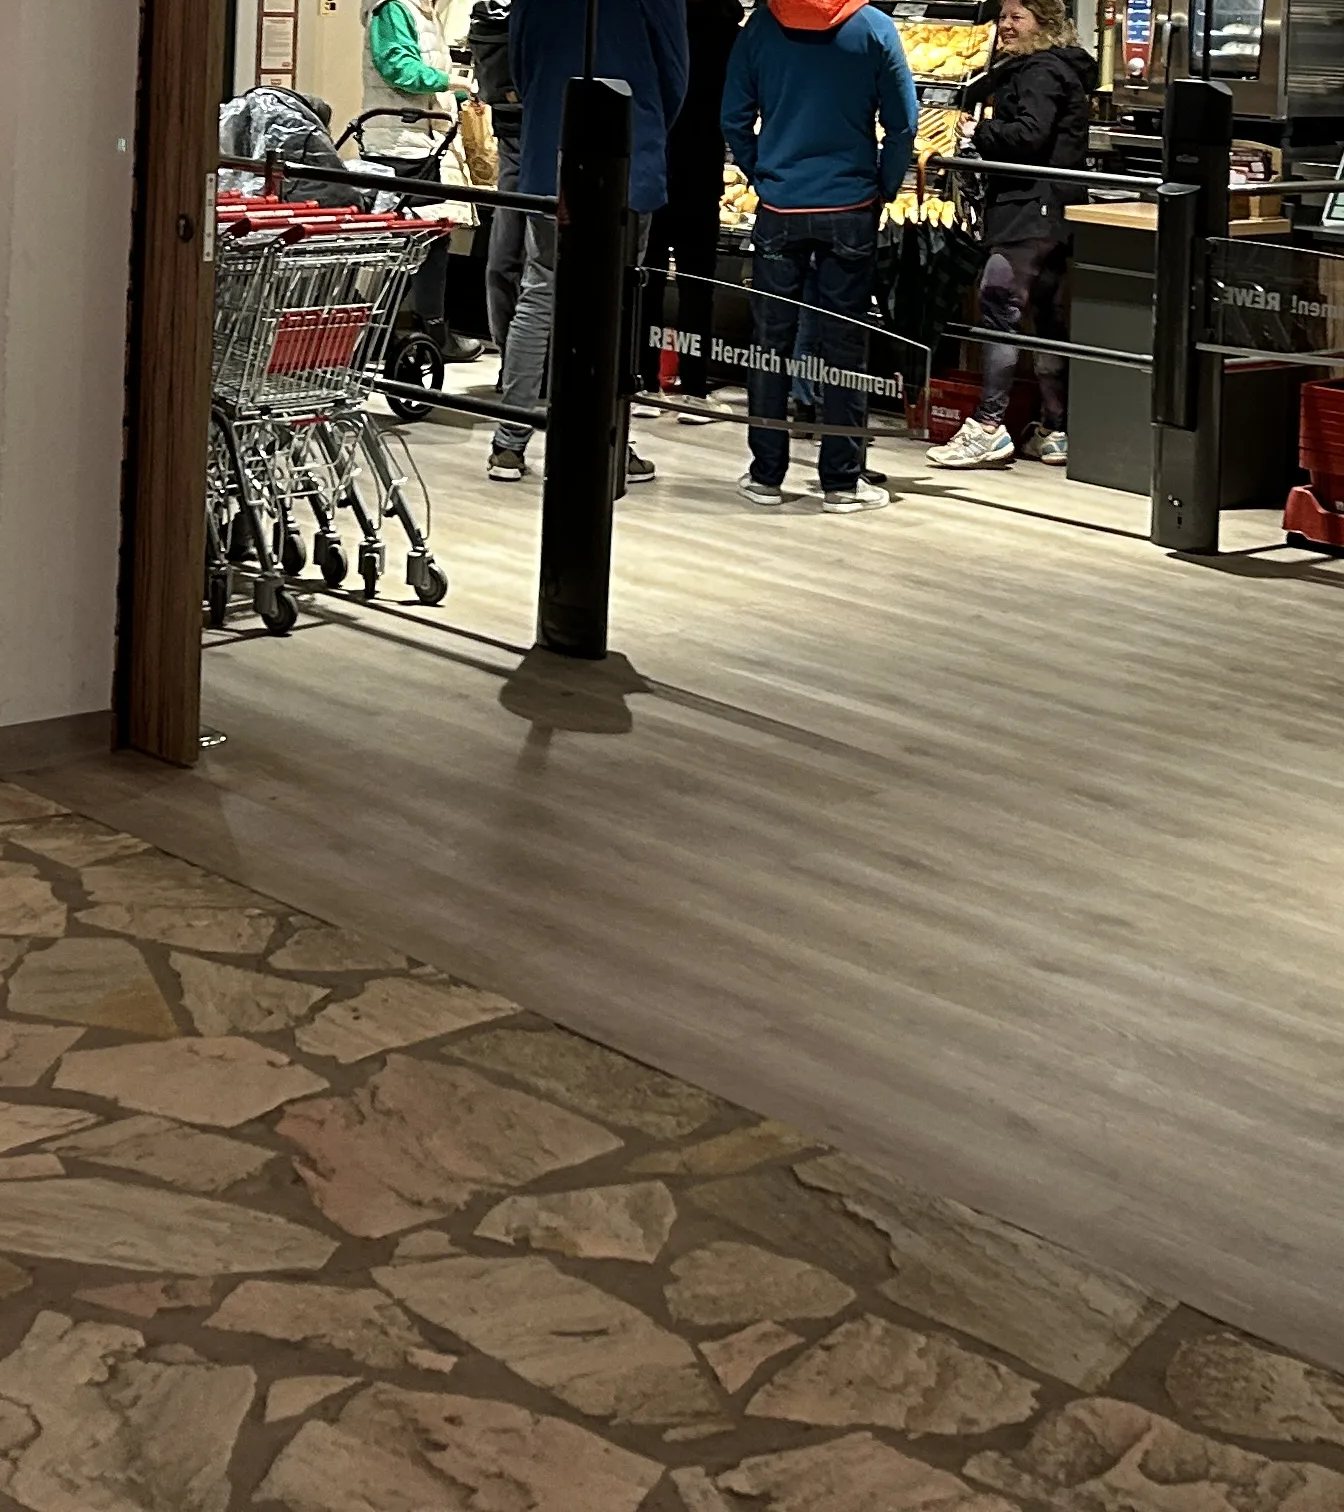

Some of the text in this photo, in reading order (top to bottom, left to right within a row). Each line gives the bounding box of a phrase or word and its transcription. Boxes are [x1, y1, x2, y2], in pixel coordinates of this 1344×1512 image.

[649, 325, 904, 400] REWE Herzlich willkommen!
